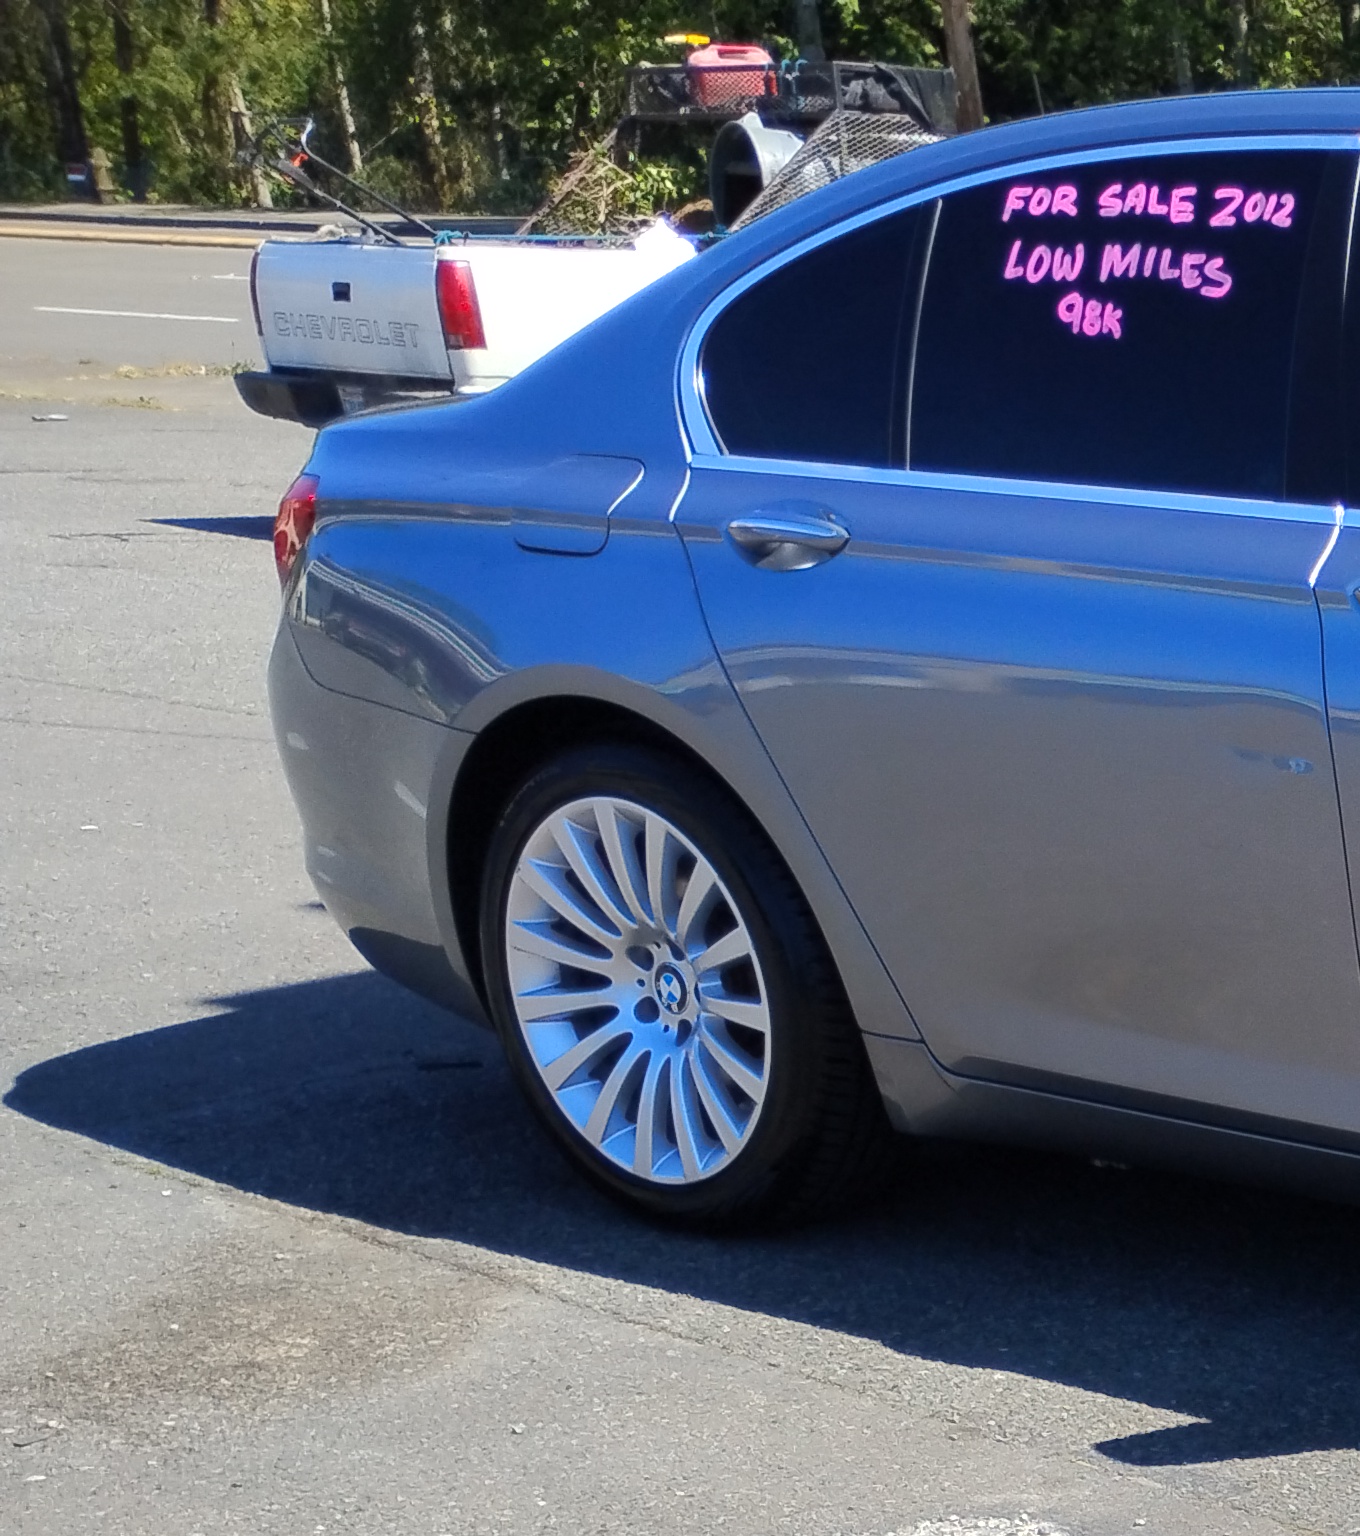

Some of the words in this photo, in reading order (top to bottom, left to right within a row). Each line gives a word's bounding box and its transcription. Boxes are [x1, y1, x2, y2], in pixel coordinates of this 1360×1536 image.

[1002, 185, 1078, 223] FOR
[1099, 183, 1197, 224] SALE
[1209, 187, 1296, 228] 2012
[1003, 240, 1084, 284] LOW
[1100, 242, 1233, 298] MILES
[273, 311, 419, 348] CHEVROLET
